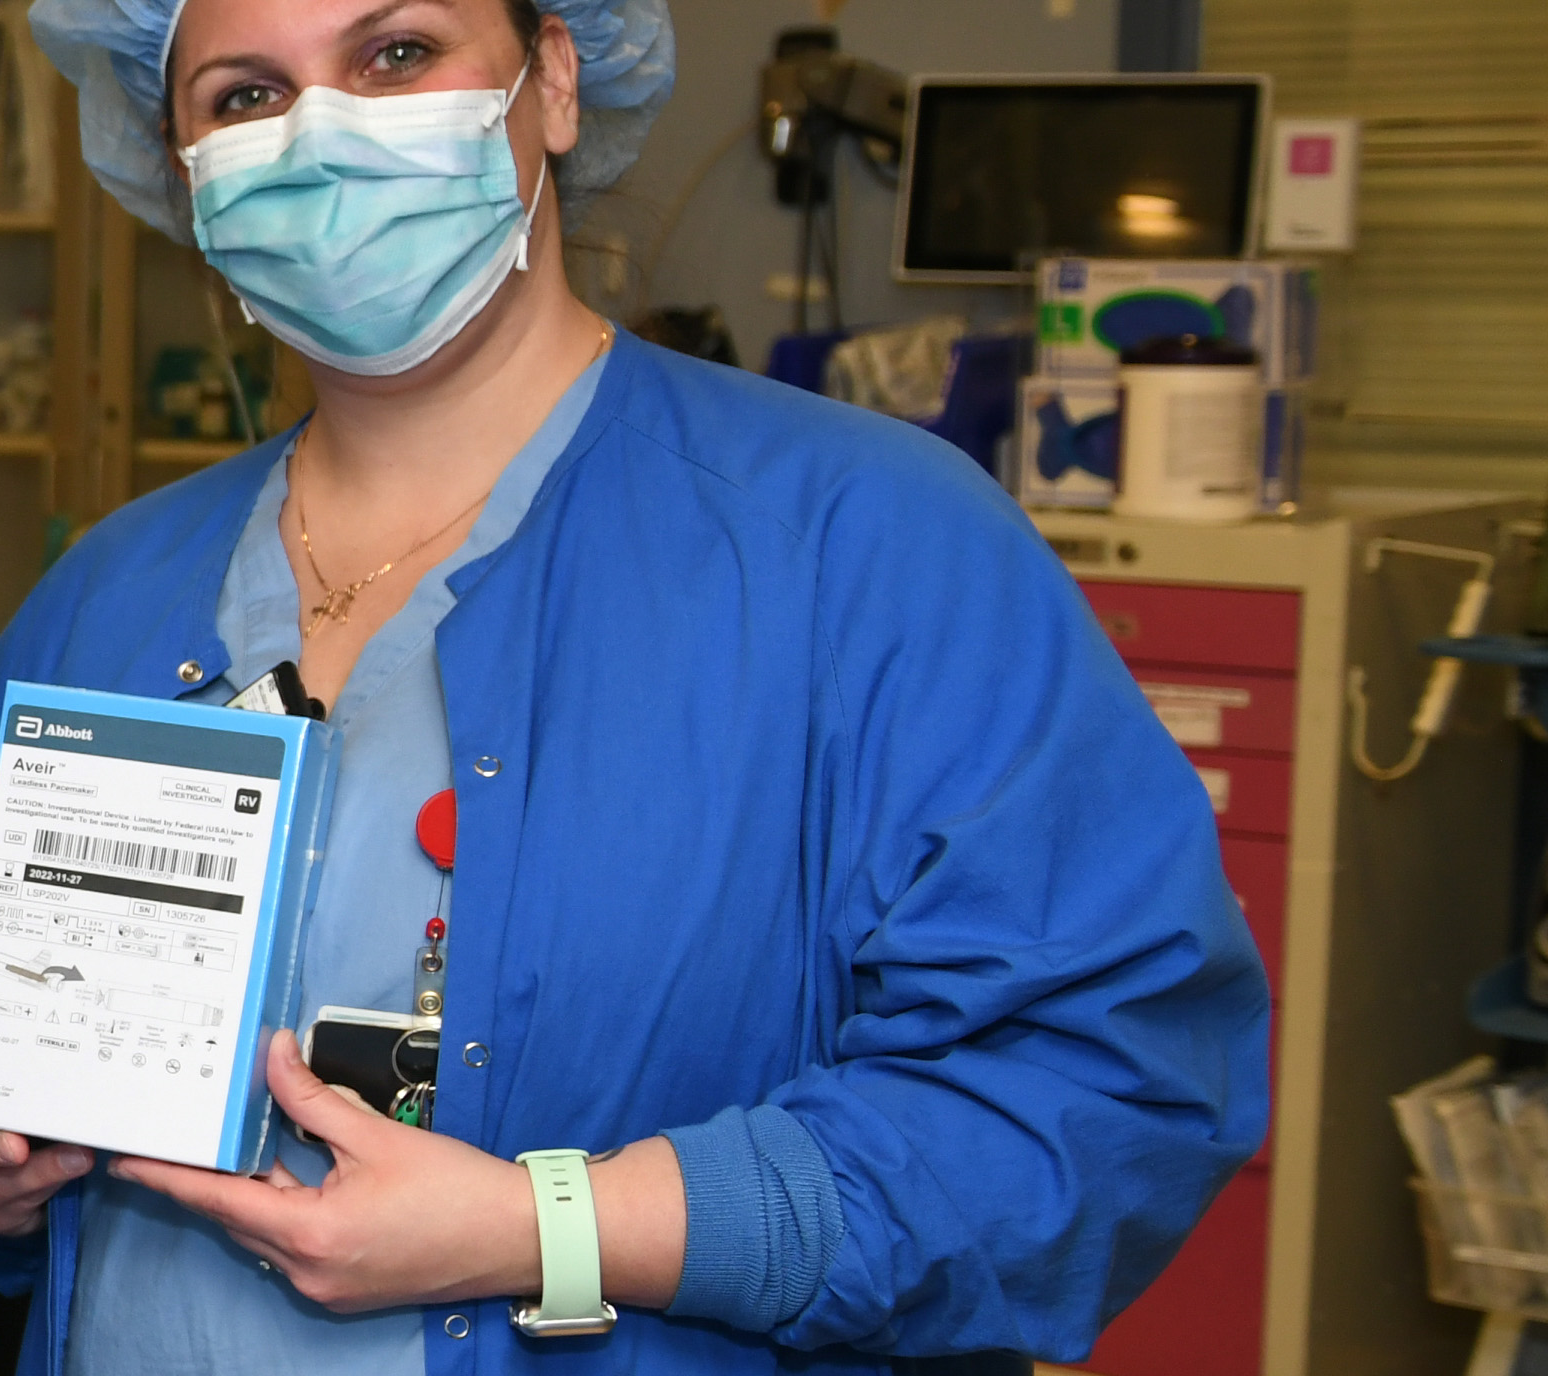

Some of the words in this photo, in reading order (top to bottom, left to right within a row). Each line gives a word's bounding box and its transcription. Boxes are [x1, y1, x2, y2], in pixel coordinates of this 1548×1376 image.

[44, 722, 94, 742] Abbott
[12, 757, 56, 775] Aveir
[12, 776, 48, 789] Leadless
[50, 781, 95, 795] Pacemaker
[175, 782, 211, 794] CLINICAL
[162, 790, 222, 804] INVESTIGATION
[238, 795, 258, 808] RV
[6, 797, 46, 809] CAUTION:
[47, 802, 103, 817] Investigational
[133, 815, 162, 826] Limited
[163, 819, 173, 829] by
[174, 821, 204, 831] Federal
[205, 825, 229, 835] (USA)
[231, 828, 244, 837] law
[8, 833, 23, 843] UDI
[78, 815, 88, 824] To
[89, 817, 99, 825] be
[100, 819, 119, 828] used
[120, 822, 131, 831] by
[132, 824, 165, 836] qualified
[166, 828, 216, 843] investigators
[29, 868, 82, 885] 2022-11-27
[0, 883, 15, 894] REF
[26, 887, 70, 902] LSP202V
[139, 905, 151, 914] SN
[166, 909, 206, 924] 1305726
[39, 1037, 65, 1048] STERILE
